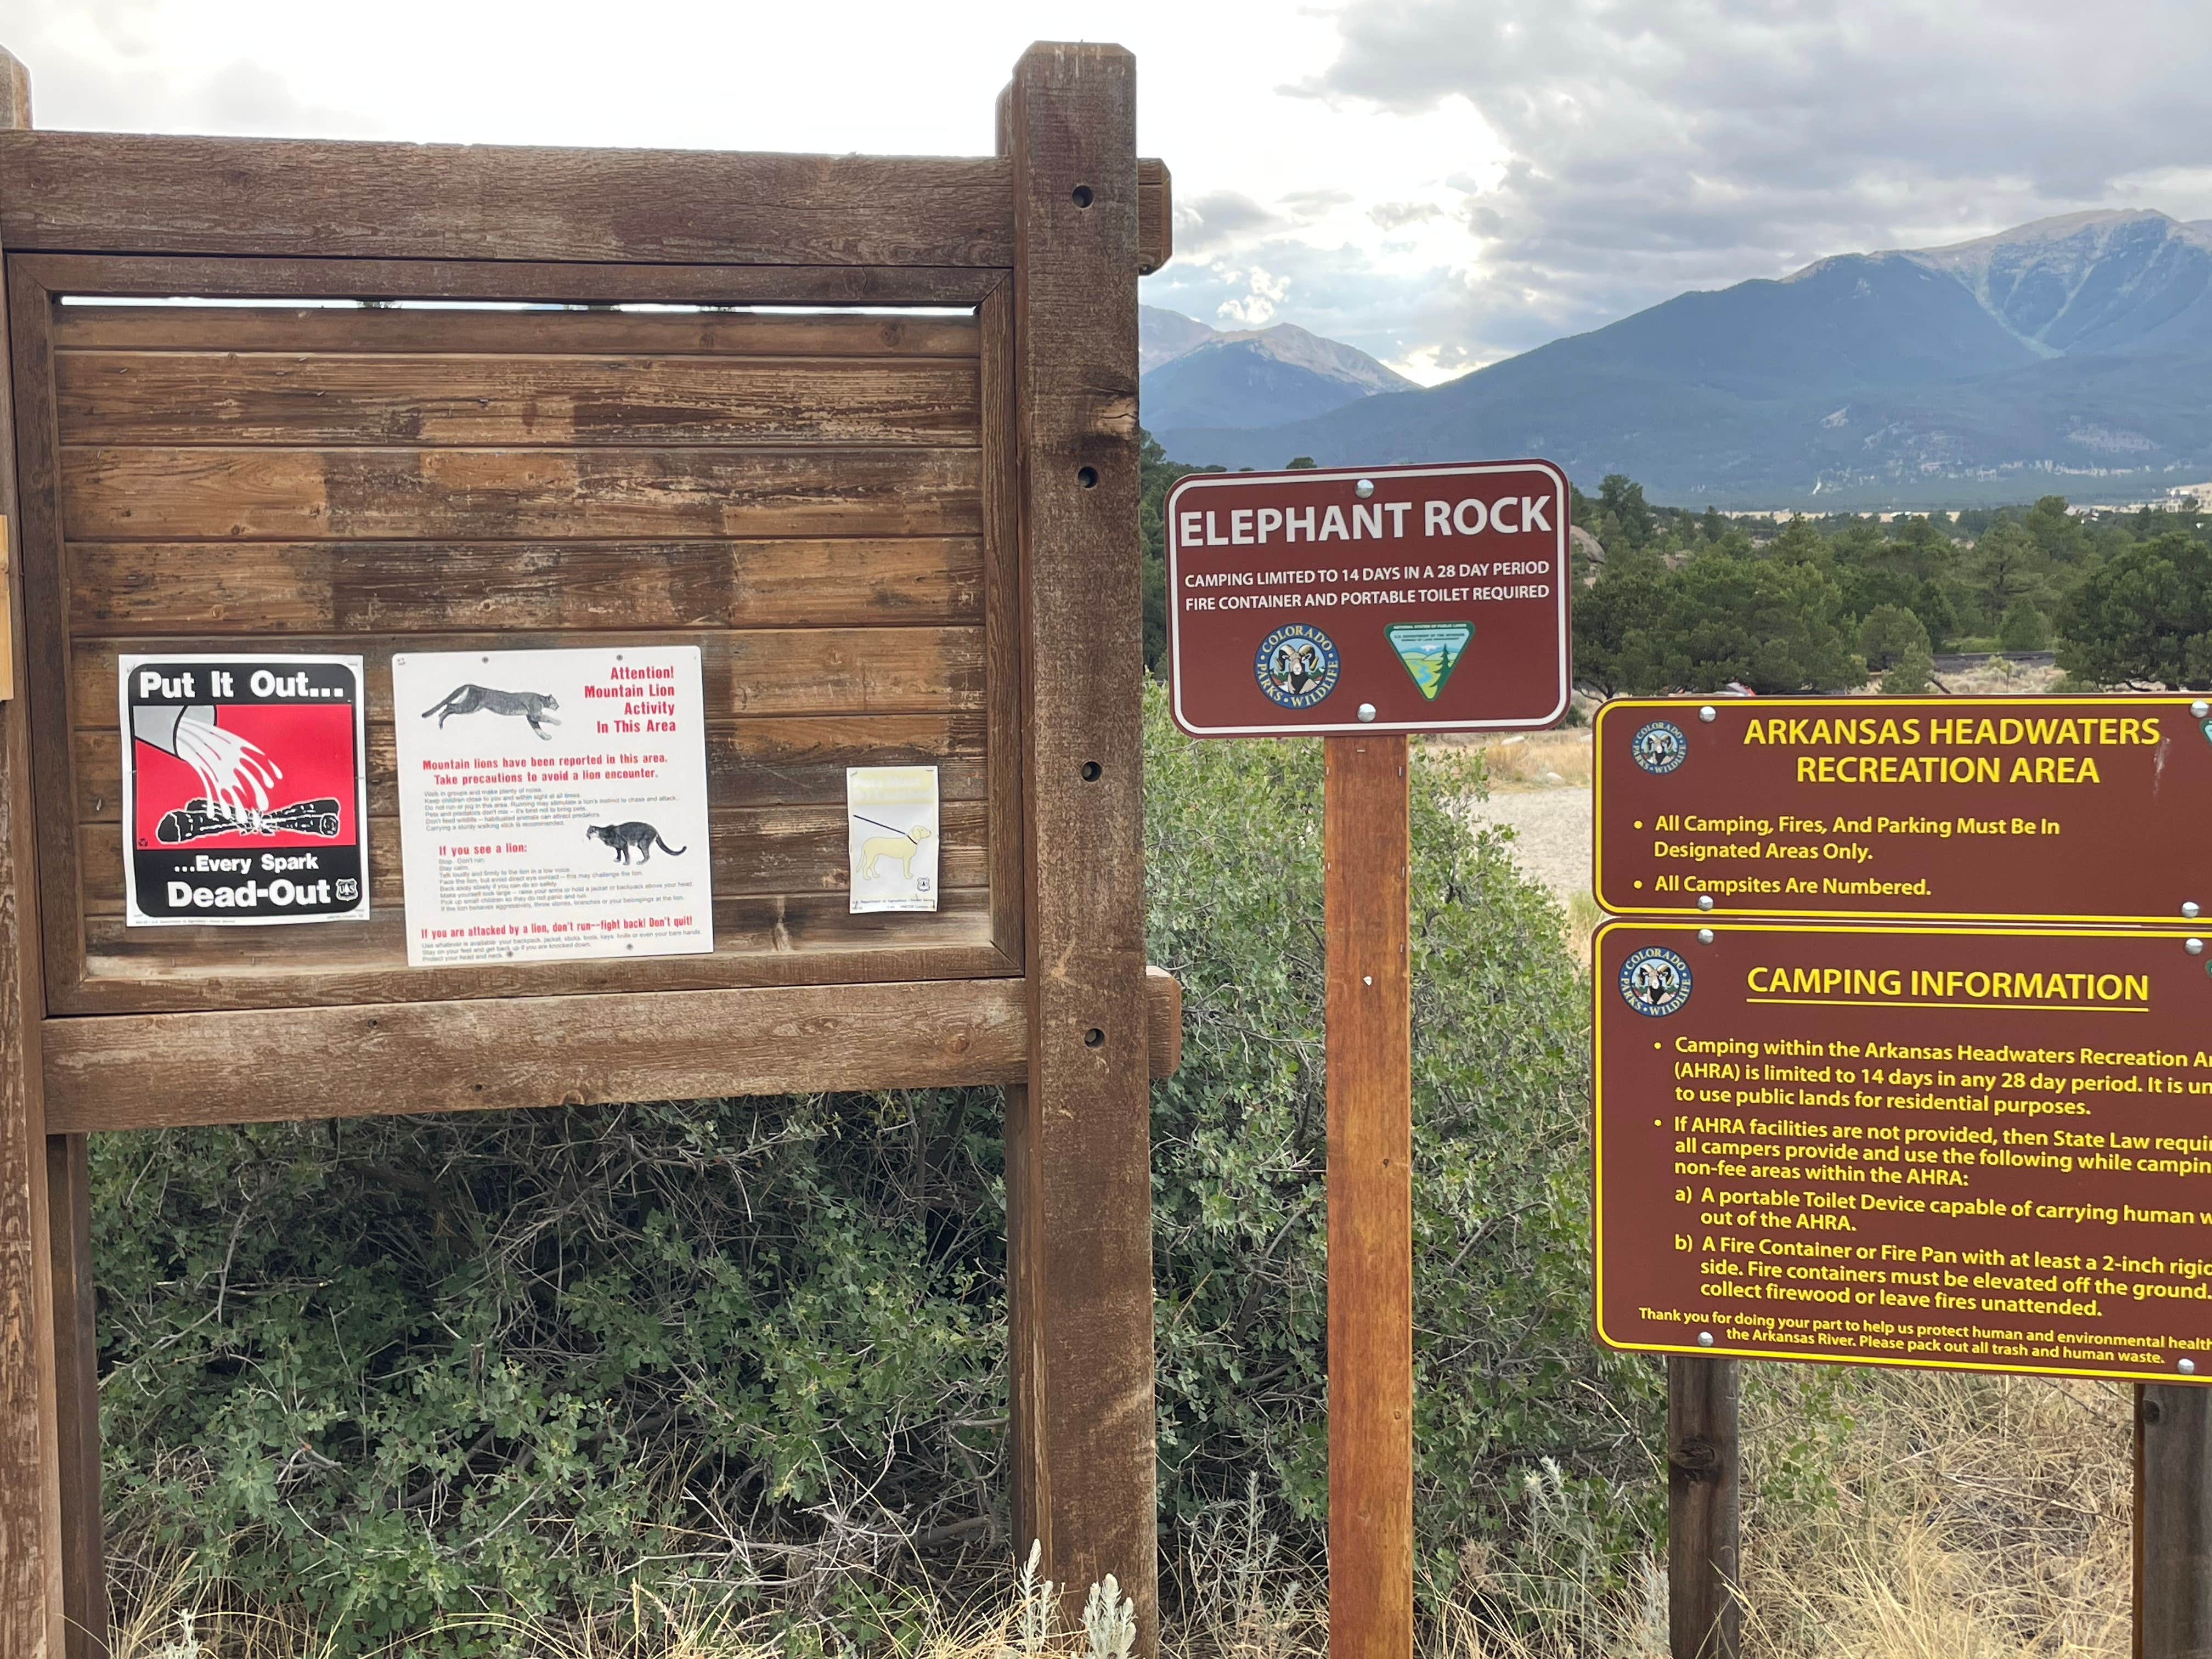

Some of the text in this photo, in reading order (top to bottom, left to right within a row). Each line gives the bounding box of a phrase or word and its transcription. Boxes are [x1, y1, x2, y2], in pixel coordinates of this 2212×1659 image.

[1181, 496, 1551, 546] ELEPHANT ROCK
[1186, 561, 1549, 587] CAMPING LIMITED TO 14 DAYS IN A 28 DAY PERIOD
[1186, 585, 1549, 611] FIRE CONTAINER AND PORTABLE TOILET REQUIRED
[1262, 625, 1333, 653] COLORADO
[140, 669, 344, 699] Put It Out...
[611, 667, 674, 680] Attention!
[1257, 663, 1283, 701] PARKS
[1290, 661, 1339, 707] WILDLIFE
[584, 685, 675, 698] Mountain Lion
[625, 701, 675, 716] Activity
[597, 720, 676, 734] In This Area
[1637, 722, 1683, 739] COLORADO
[1745, 718, 2160, 744] ARKANSAS HEADWATERS
[422, 755, 668, 770] Mountain lions have been reported in this area.
[1798, 757, 2100, 783] RECREATION AREA
[436, 775, 458, 786] Take
[462, 774, 522, 786] precautions
[527, 772, 537, 782] to
[543, 772, 569, 781] avoid
[583, 771, 601, 780] lion
[606, 768, 658, 779] encounter.
[1656, 816, 2060, 838] All Camping, Fires, And Parking Must Be In
[439, 847, 447, 855] If
[452, 847, 470, 857] you
[475, 847, 492, 855] see
[506, 844, 527, 853] lion:
[1655, 842, 1872, 862] Designated Areas Only.
[174, 854, 319, 874] ...Every Spark
[167, 879, 331, 908] Dead-Out
[1656, 876, 1930, 896] All Campsites Are Numbered.
[422, 930, 428, 939] If
[432, 930, 447, 939] you
[451, 929, 465, 938] are
[469, 926, 506, 938] attacked
[510, 925, 521, 936] by
[532, 924, 549, 933] lion,
[553, 923, 573, 932] don't
[577, 921, 621, 933] run--fight
[624, 919, 645, 929] back!
[649, 918, 670, 927] Don't
[674, 917, 692, 928] quit!
[1626, 948, 1686, 970] COLORADO
[1621, 978, 1643, 1010] PARKS
[1649, 979, 1691, 1015] WILDLIFE
[1748, 967, 2149, 1001] CAMPING INFORMATION
[1676, 1037, 1759, 1058] Camping
[1764, 1040, 1824, 1056] within
[1829, 1042, 1861, 1058] the
[1866, 1043, 1953, 1060] Arkansas
[1959, 1046, 2075, 1064] Headwaters
[2081, 1048, 2189, 1066] Recreation
[1676, 1088, 2090, 1116] to use public lands for residential purposes.
[1701, 1282, 2101, 1317] collect firewood or leave fires unattended.
[1639, 1308, 1680, 1321] Thank
[1684, 1314, 1709, 1324] you
[1713, 1312, 1731, 1324] for
[1733, 1314, 1775, 1328] doing
[1779, 1319, 1809, 1330] your
[1813, 1321, 1842, 1332] part
[1846, 1321, 1860, 1331] to
[1864, 1321, 1895, 1336] help
[1898, 1326, 1914, 1334] us
[1917, 1327, 1969, 1337] protect
[1973, 1327, 2023, 1340] human
[2027, 1331, 2055, 1342] and
[2058, 1334, 2166, 1348] environmental
[1727, 1329, 2165, 1363] the Arkansas River. Please pack out all trash and human waste.
